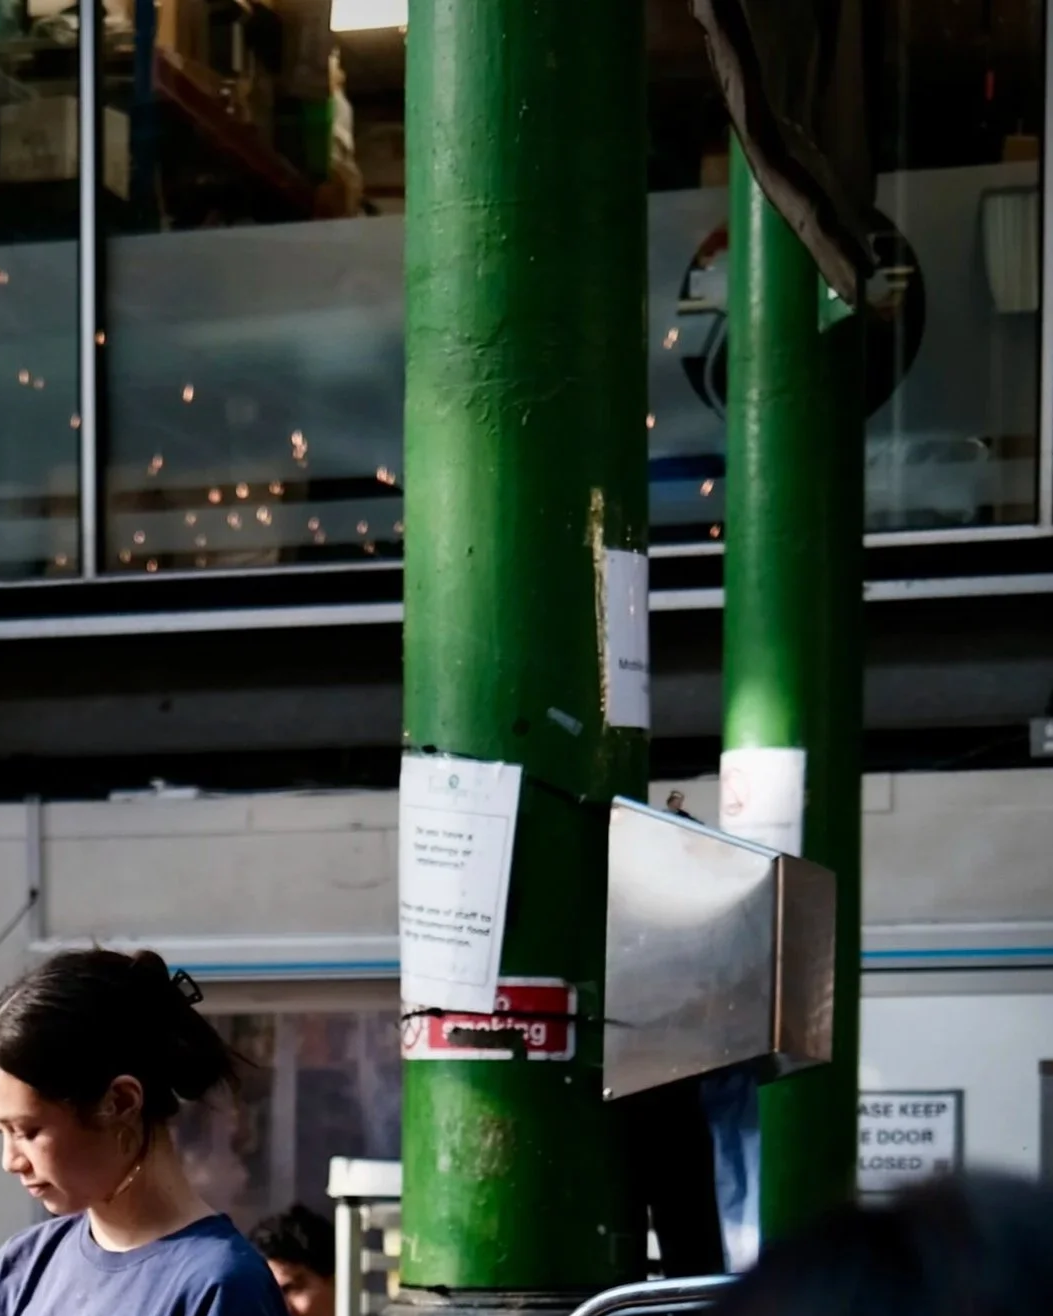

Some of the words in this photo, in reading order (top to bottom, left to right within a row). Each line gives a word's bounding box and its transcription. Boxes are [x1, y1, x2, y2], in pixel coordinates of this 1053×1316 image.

[899, 1102, 947, 1117] KEEP
[876, 1129, 934, 1145] DOOR
[859, 1156, 922, 1170] LOSED
